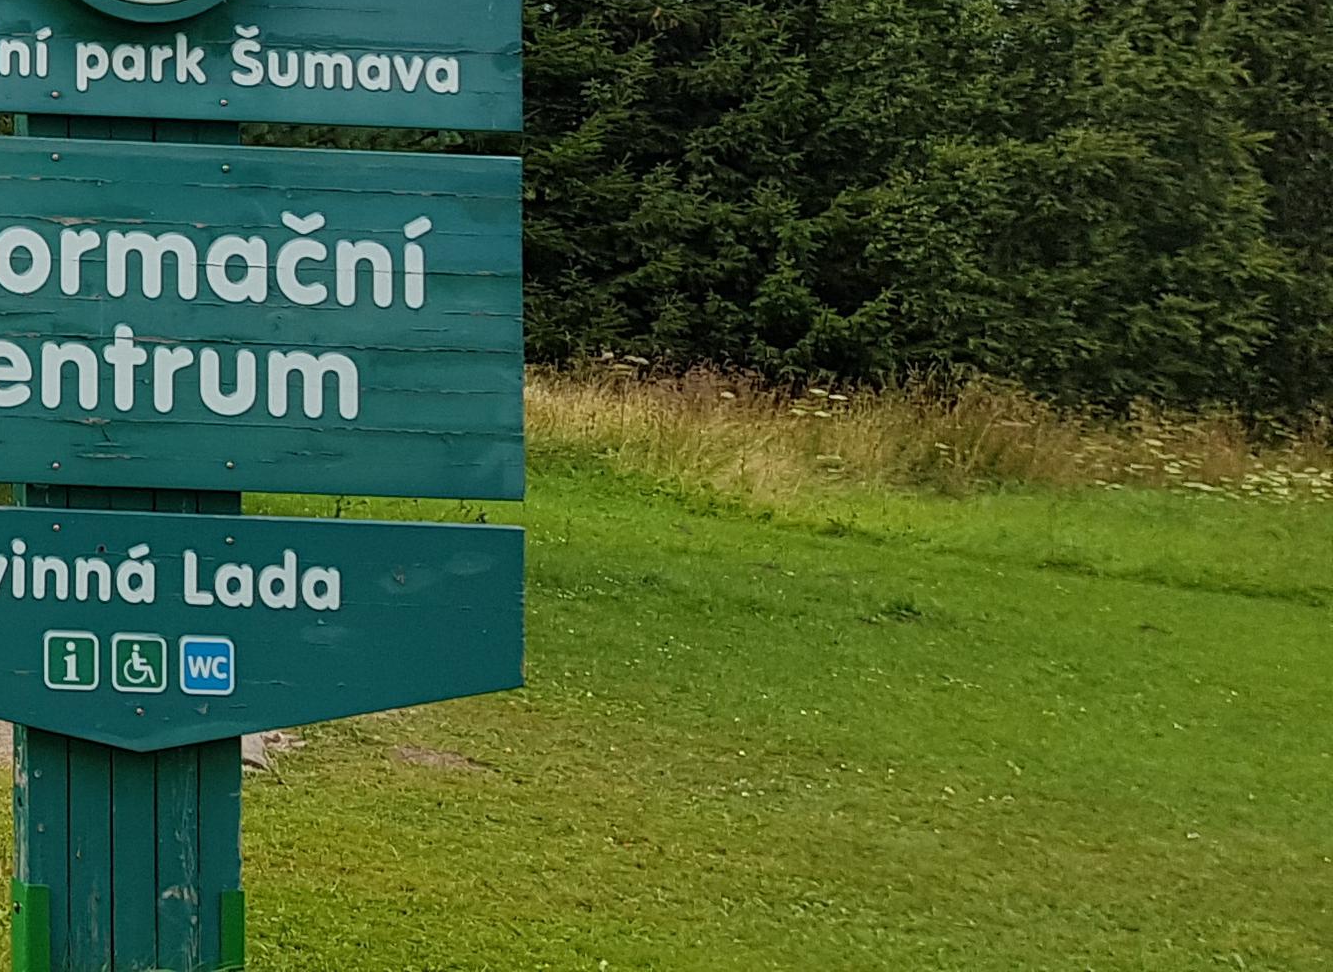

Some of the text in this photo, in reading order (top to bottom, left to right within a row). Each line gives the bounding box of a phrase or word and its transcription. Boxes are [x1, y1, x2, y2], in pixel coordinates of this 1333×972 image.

[75, 33, 207, 93] park
[231, 25, 460, 95] Šumava
[183, 550, 341, 611] Lada
[187, 654, 228, 680] WC
